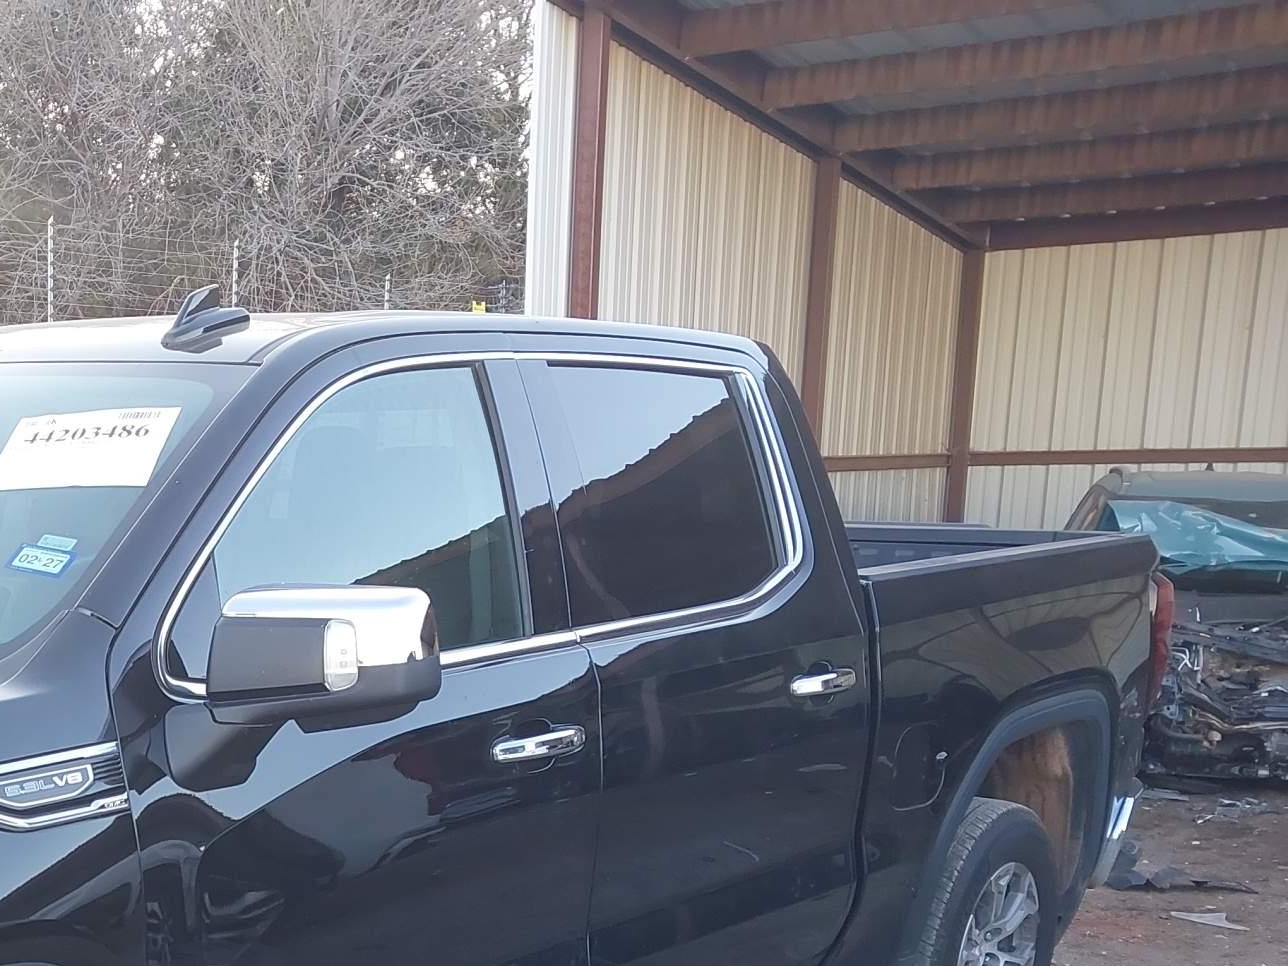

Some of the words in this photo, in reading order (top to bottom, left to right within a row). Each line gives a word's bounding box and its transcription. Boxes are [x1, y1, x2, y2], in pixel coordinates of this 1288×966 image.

[23, 424, 150, 444] 44203486
[18, 553, 39, 565] 02
[42, 557, 64, 569] 27
[52, 771, 83, 787] V8
